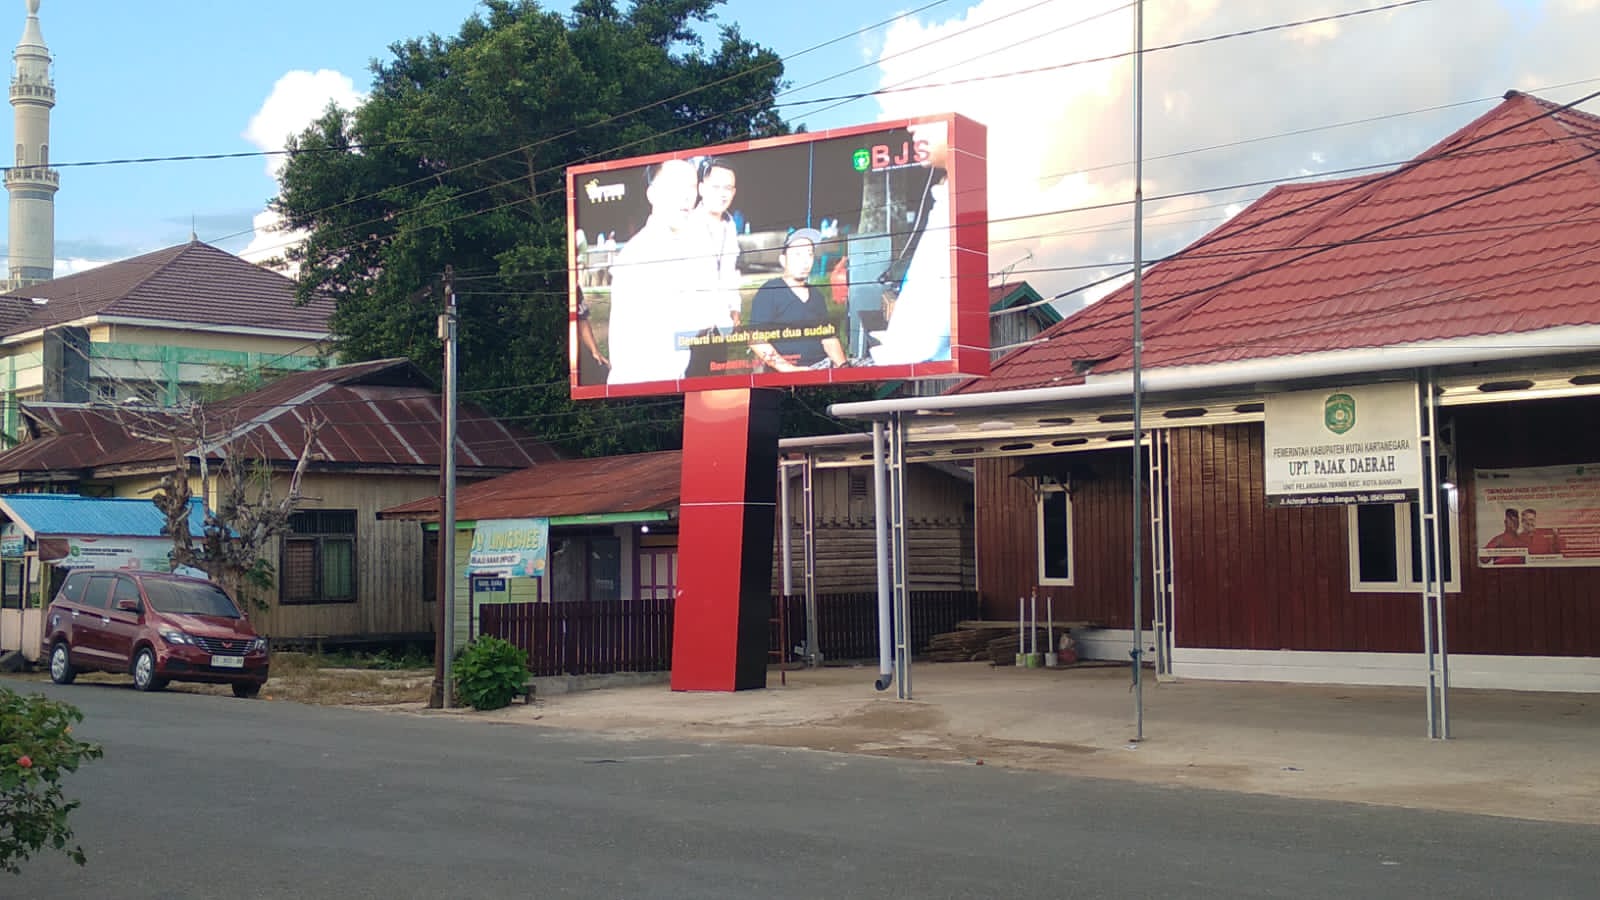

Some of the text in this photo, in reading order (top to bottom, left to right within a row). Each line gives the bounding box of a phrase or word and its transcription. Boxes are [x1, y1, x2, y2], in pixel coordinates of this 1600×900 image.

[871, 140, 929, 169] BJS
[678, 323, 835, 346] Berarti ini udah dapet dua sudah
[1273, 440, 1410, 458] PEMERINTAH KABUPATEN KUTAI KARTANEGARA
[1289, 455, 1395, 476] UPT. PAJAK DAERAH
